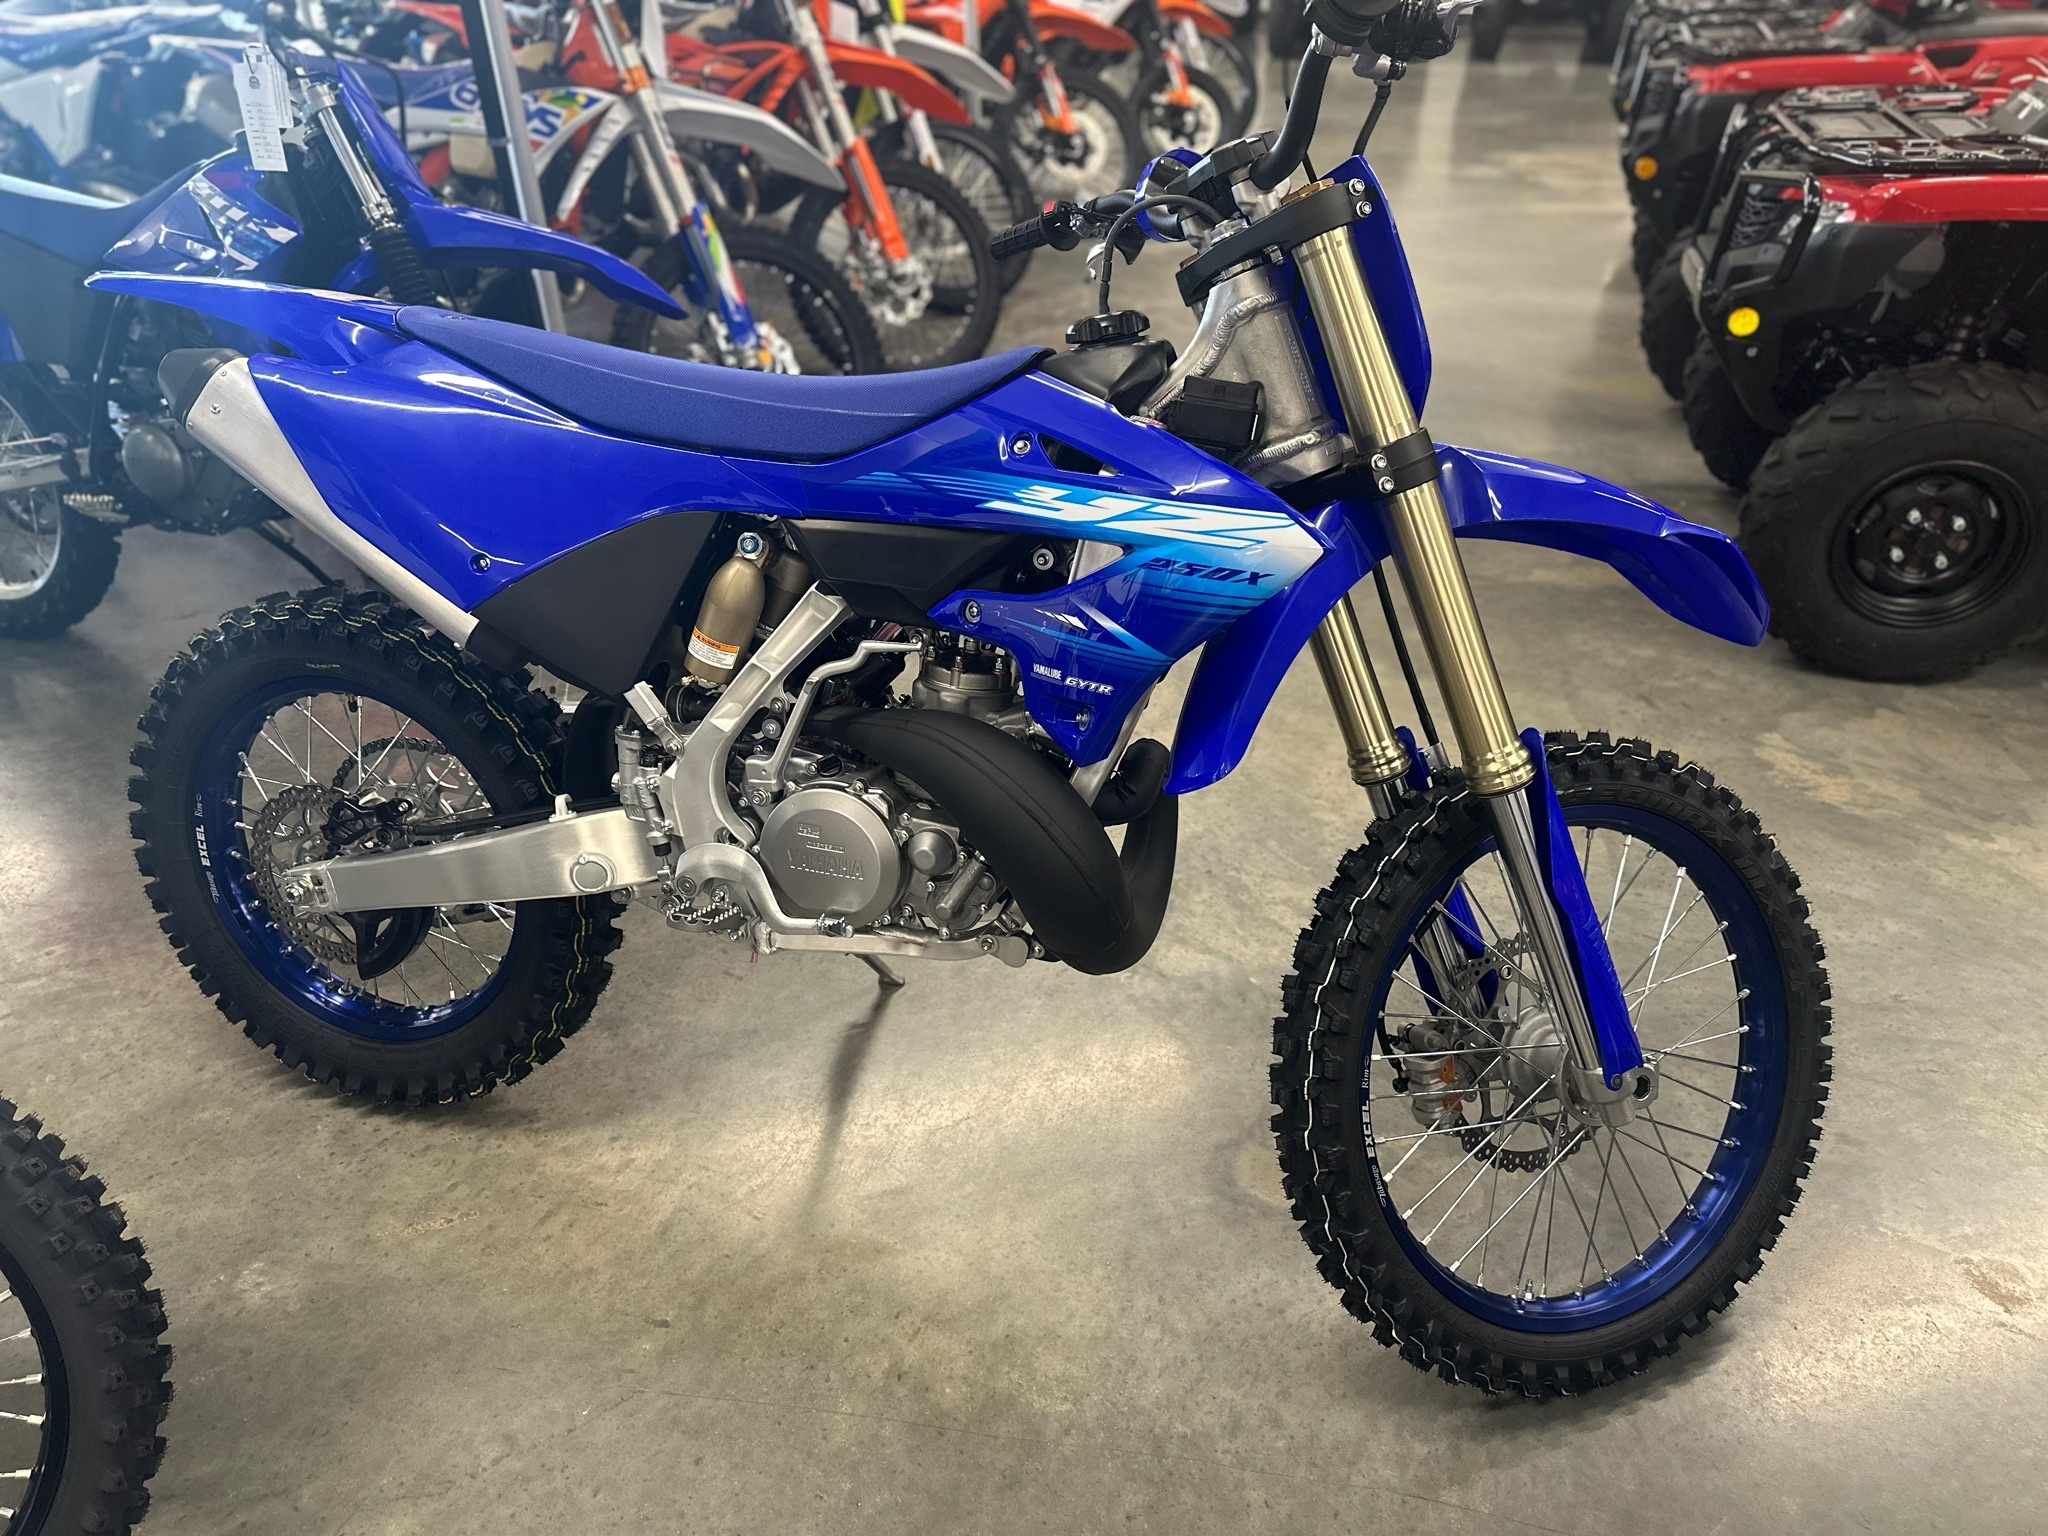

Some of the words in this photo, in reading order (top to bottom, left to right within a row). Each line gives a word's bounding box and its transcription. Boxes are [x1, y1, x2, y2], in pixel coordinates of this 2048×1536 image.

[976, 485, 1299, 549] YZ
[1138, 557, 1275, 587] 250X
[1033, 662, 1062, 680] YAMALUBE
[1063, 675, 1114, 696] GYTR
[194, 797, 203, 817] Rim
[195, 824, 211, 867] EXCEL
[787, 848, 864, 881] YAMAHA
[1361, 1063, 1370, 1089] Rim
[1361, 1100, 1375, 1159] EXCEL
[1371, 1165, 1387, 1204] Takasago
